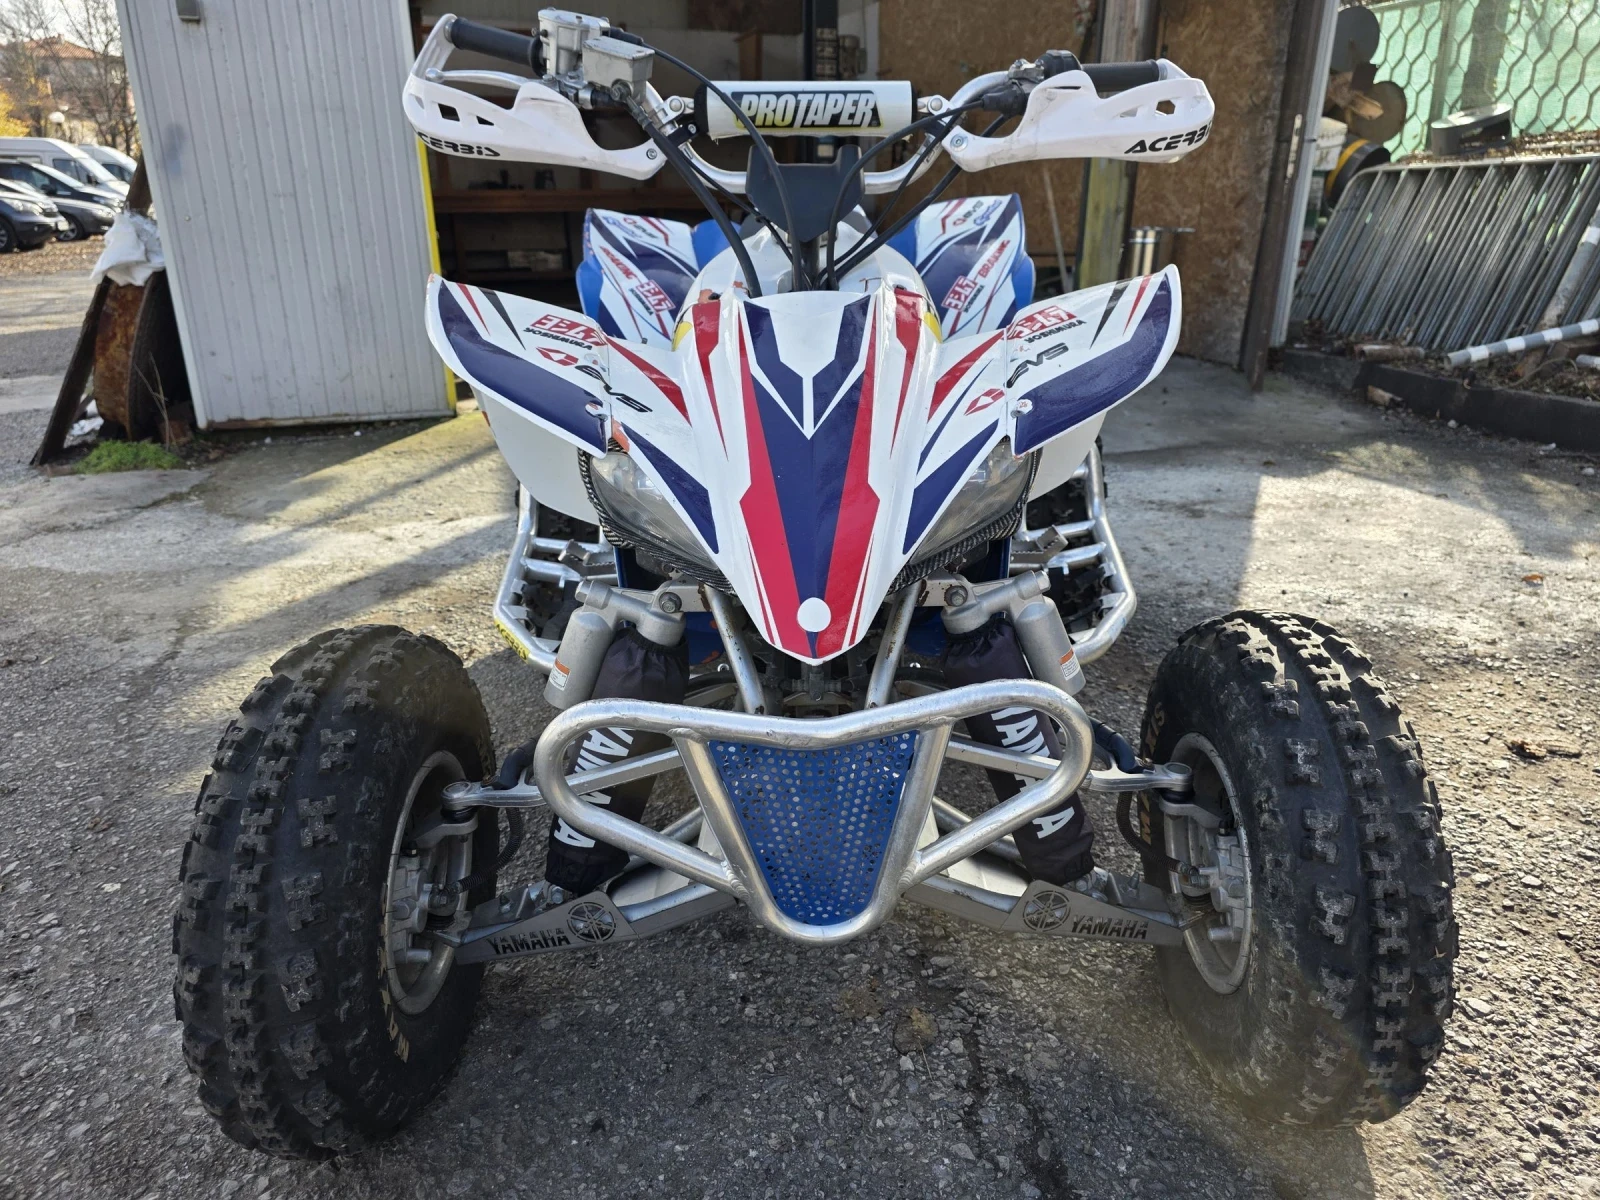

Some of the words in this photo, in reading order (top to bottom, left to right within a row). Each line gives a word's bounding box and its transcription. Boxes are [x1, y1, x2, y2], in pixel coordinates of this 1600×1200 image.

[738, 93, 876, 128] PROTAPER
[411, 124, 501, 157] CERBIS
[1124, 120, 1212, 154] ACERBI
[523, 327, 593, 350] YOSHIMURA
[1024, 319, 1086, 343] YOSHIMURA
[1071, 914, 1148, 939] YAMAHA
[486, 928, 571, 955] YAMAHA
